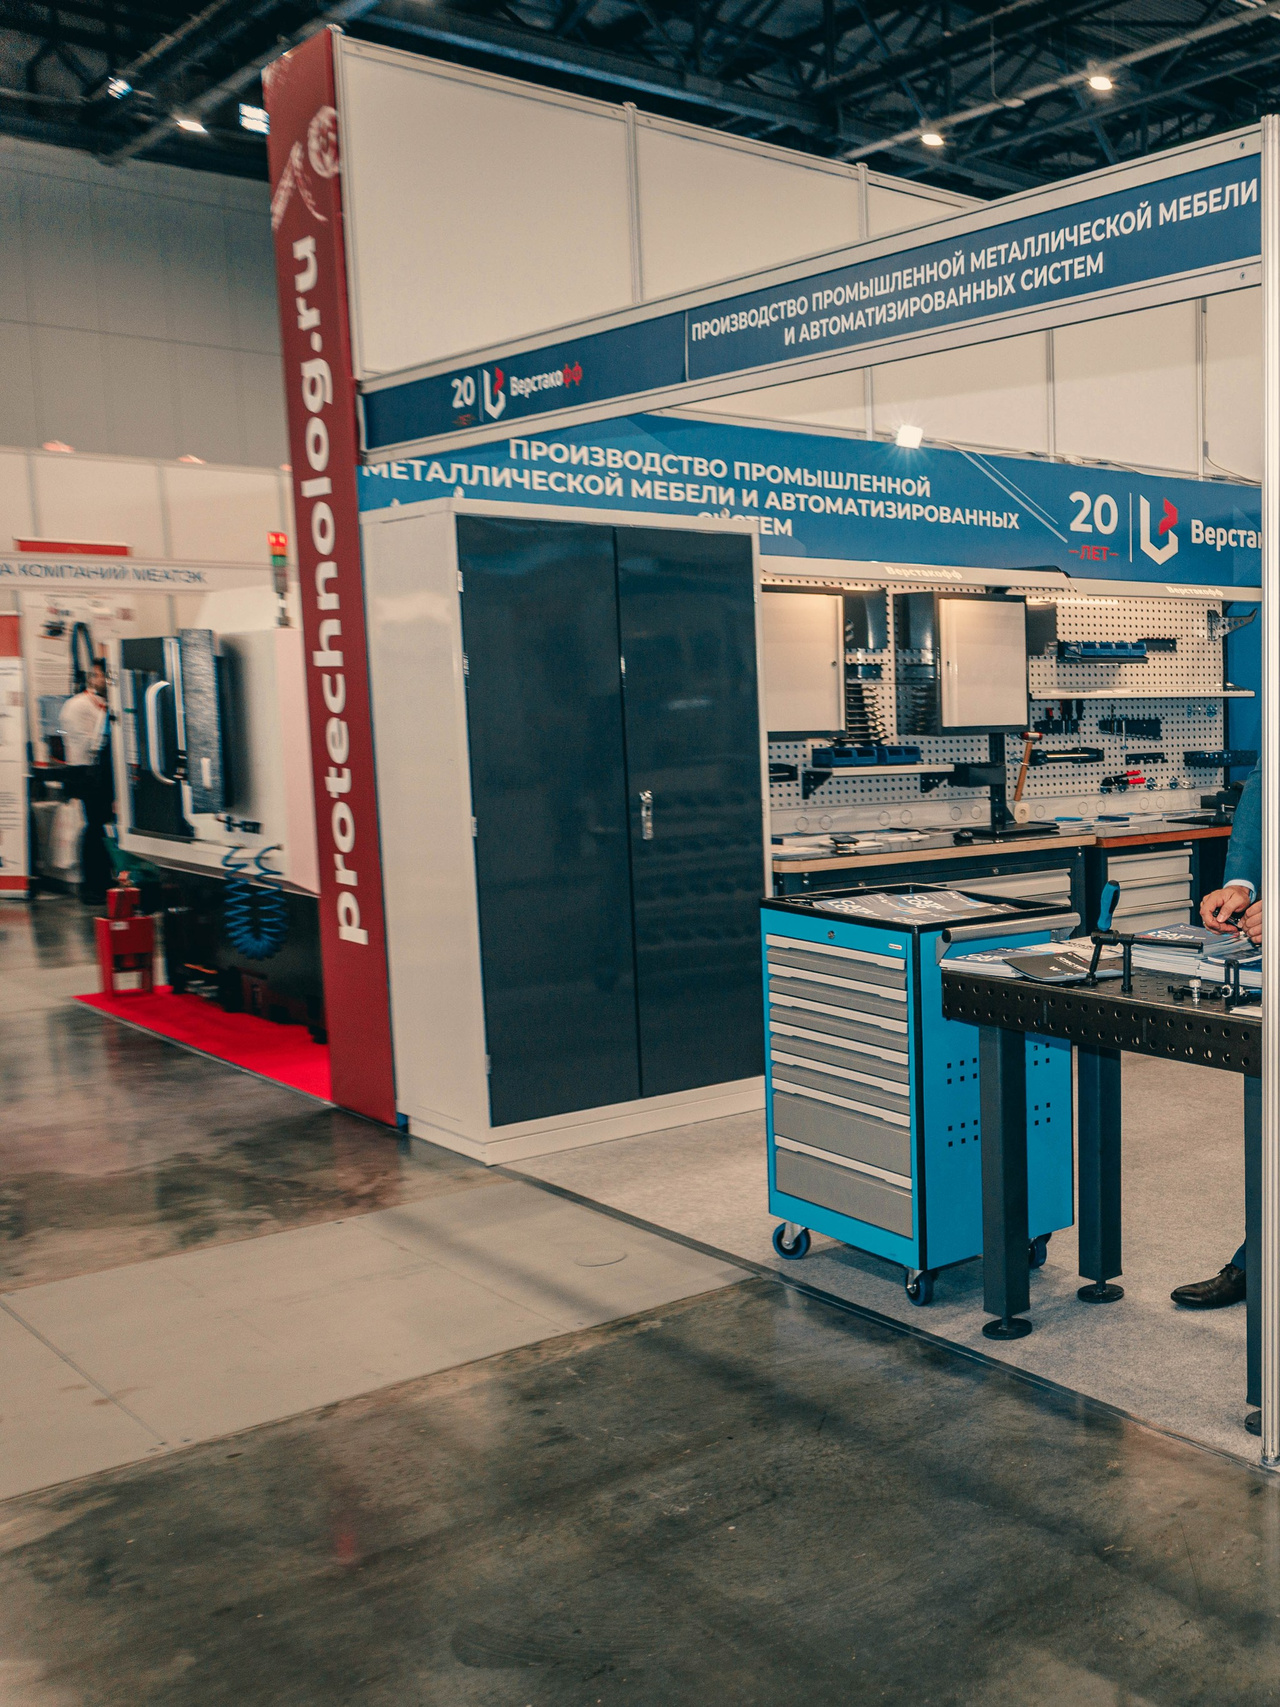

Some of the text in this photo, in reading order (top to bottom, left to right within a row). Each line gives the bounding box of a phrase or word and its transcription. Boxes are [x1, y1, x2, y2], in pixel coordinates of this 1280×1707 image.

[691, 178, 1258, 341] ПРОИЗВОДСТВО ПРОМЫШЛЕННОЙ МЕТАЛЛИЧЕСКОЙ МЕБЕЛИ
[784, 252, 1104, 346] И АВТОМАТИЗИРОВАННЫХ СИСТЕМ
[451, 361, 583, 409] 20 Верстакофф
[509, 438, 931, 498] ПРОИЗВОДСТВО ПРОМЫШЛЕННОЙ
[631, 479, 736, 507] МЕБЕЛИ
[742, 489, 758, 508] И
[764, 490, 1020, 530] АВТОМАТИЗИРОВАННЫХ
[1068, 490, 1119, 535] 20
[293, 235, 369, 947] protechnolog.ru
[884, 565, 963, 580] Верстакофф
